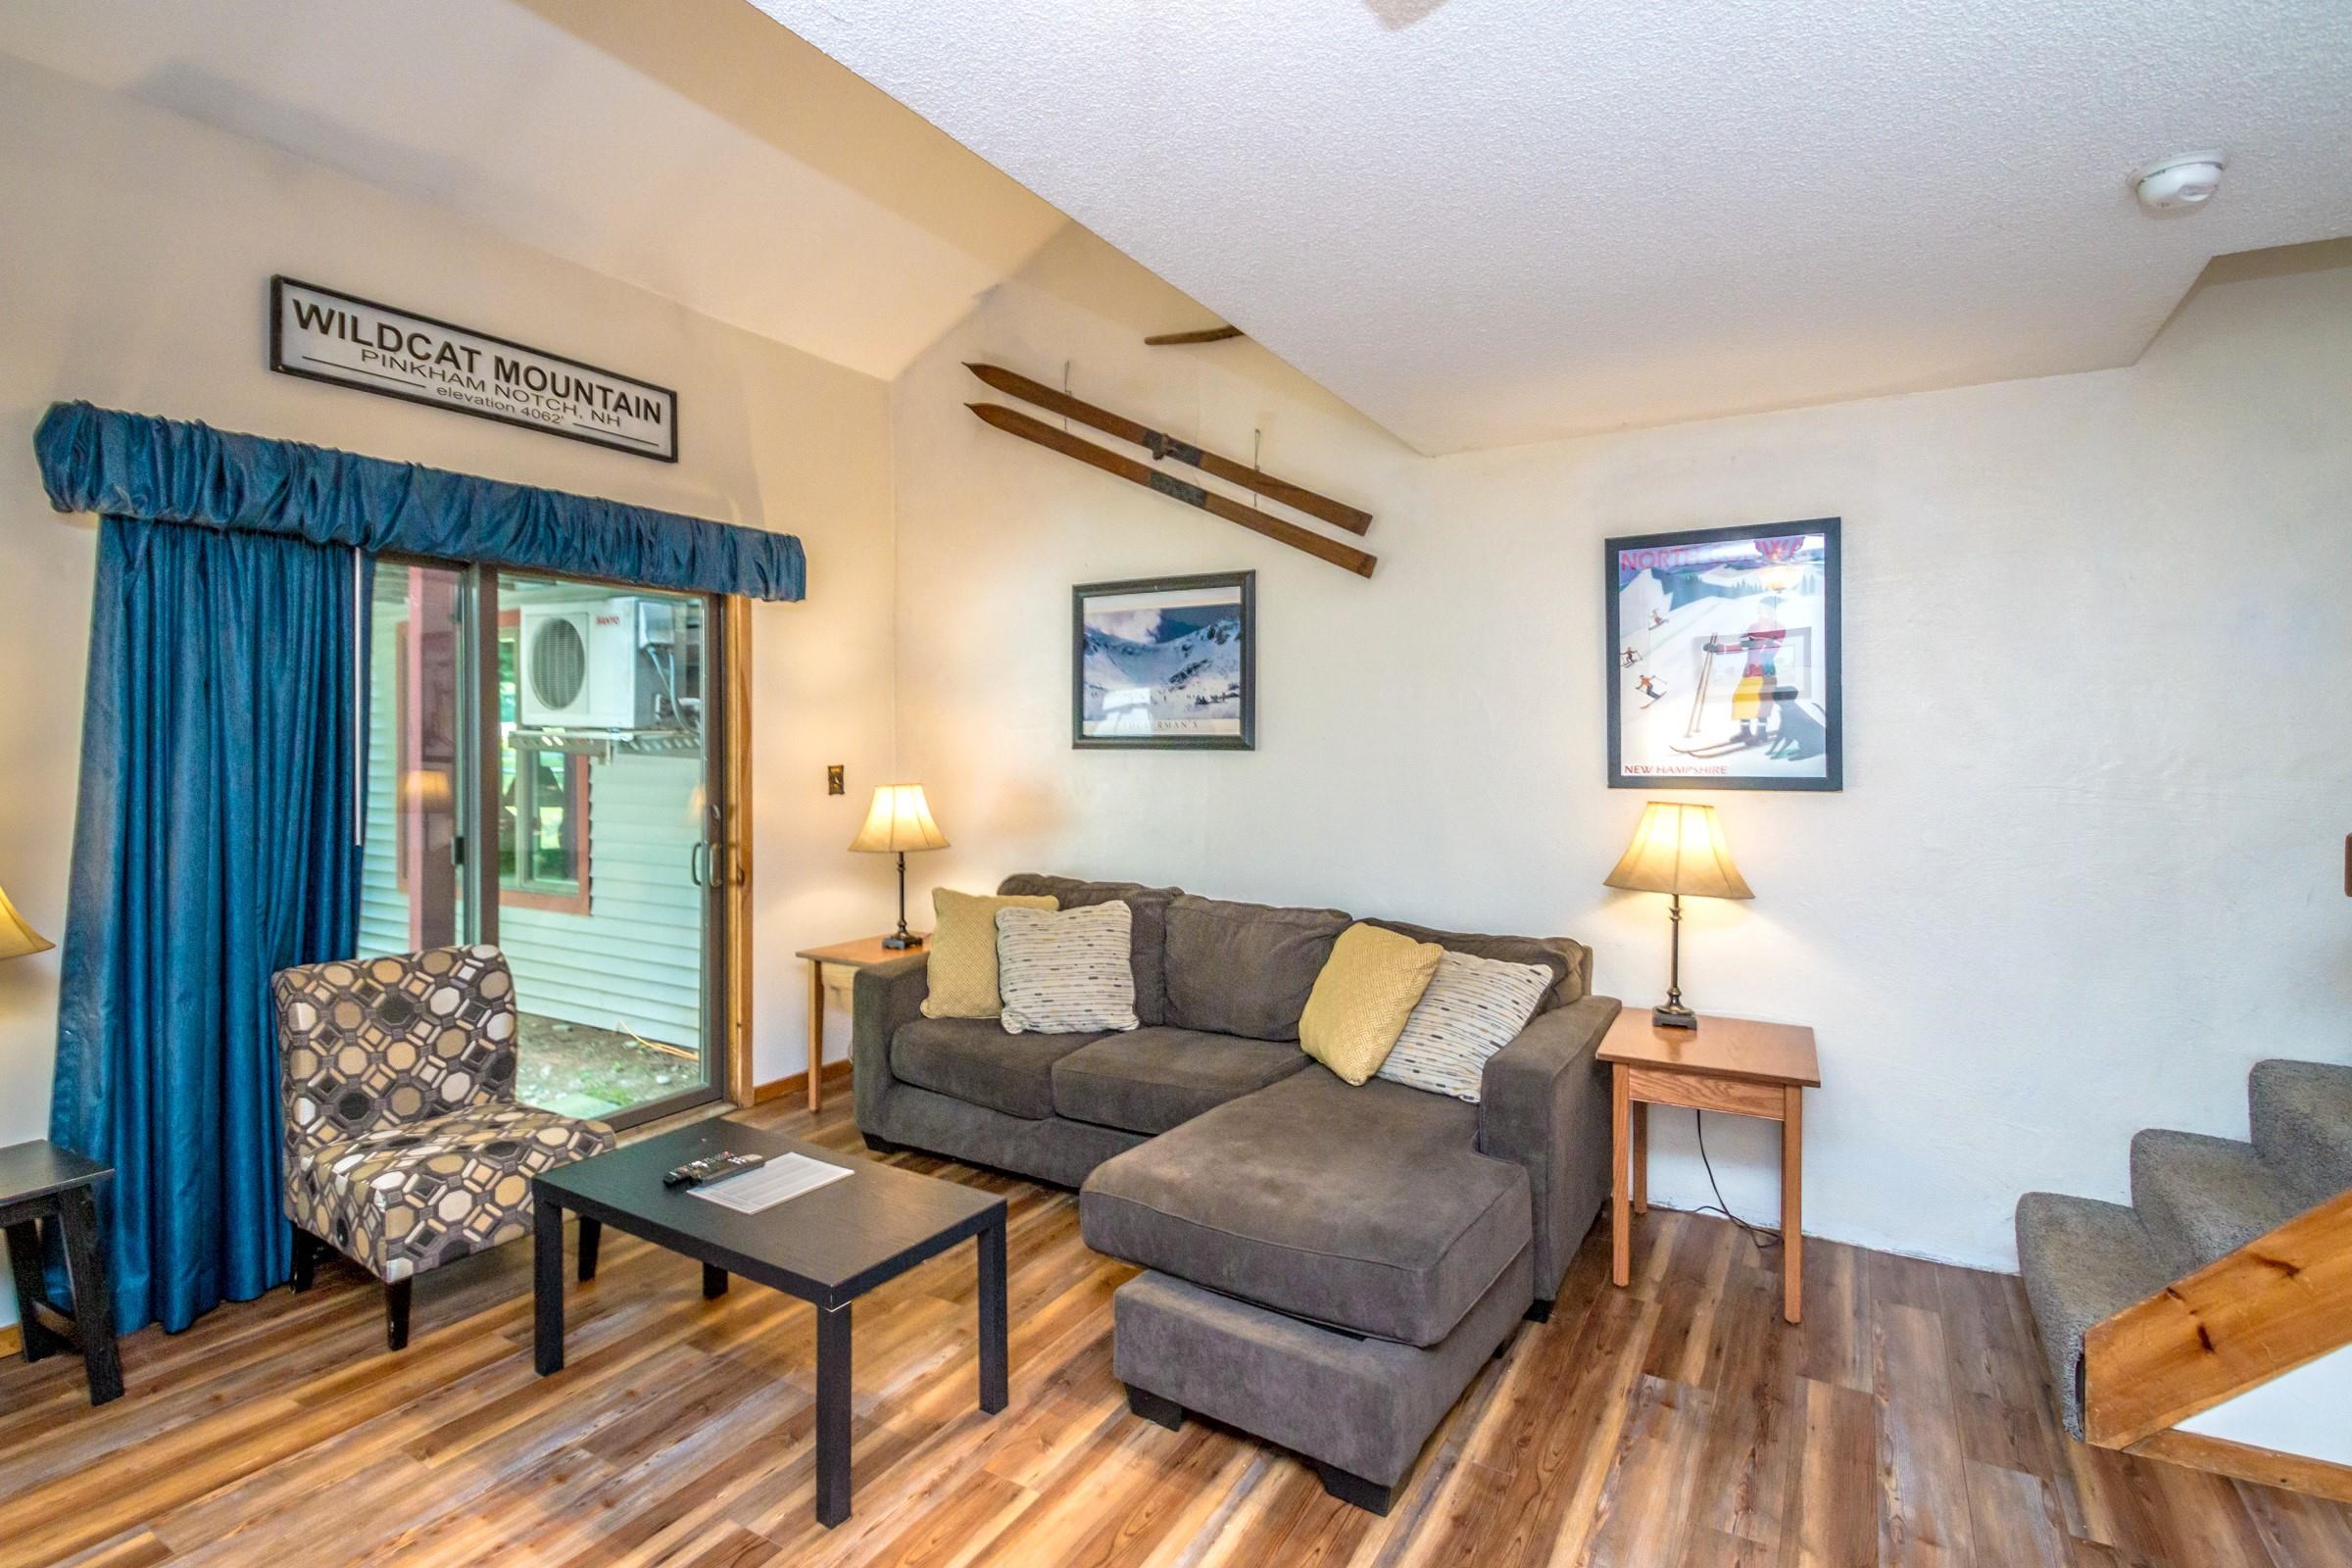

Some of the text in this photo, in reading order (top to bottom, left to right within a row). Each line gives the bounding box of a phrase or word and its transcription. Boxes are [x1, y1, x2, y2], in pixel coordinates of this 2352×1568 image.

[292, 299, 662, 424] WILDCAT MOUNTAIN
[361, 349, 620, 427] PINKHAM NOTCH, NH
[436, 387, 564, 424] elevation 4062'
[1624, 764, 1728, 774] NEW HAMPSHIRE
